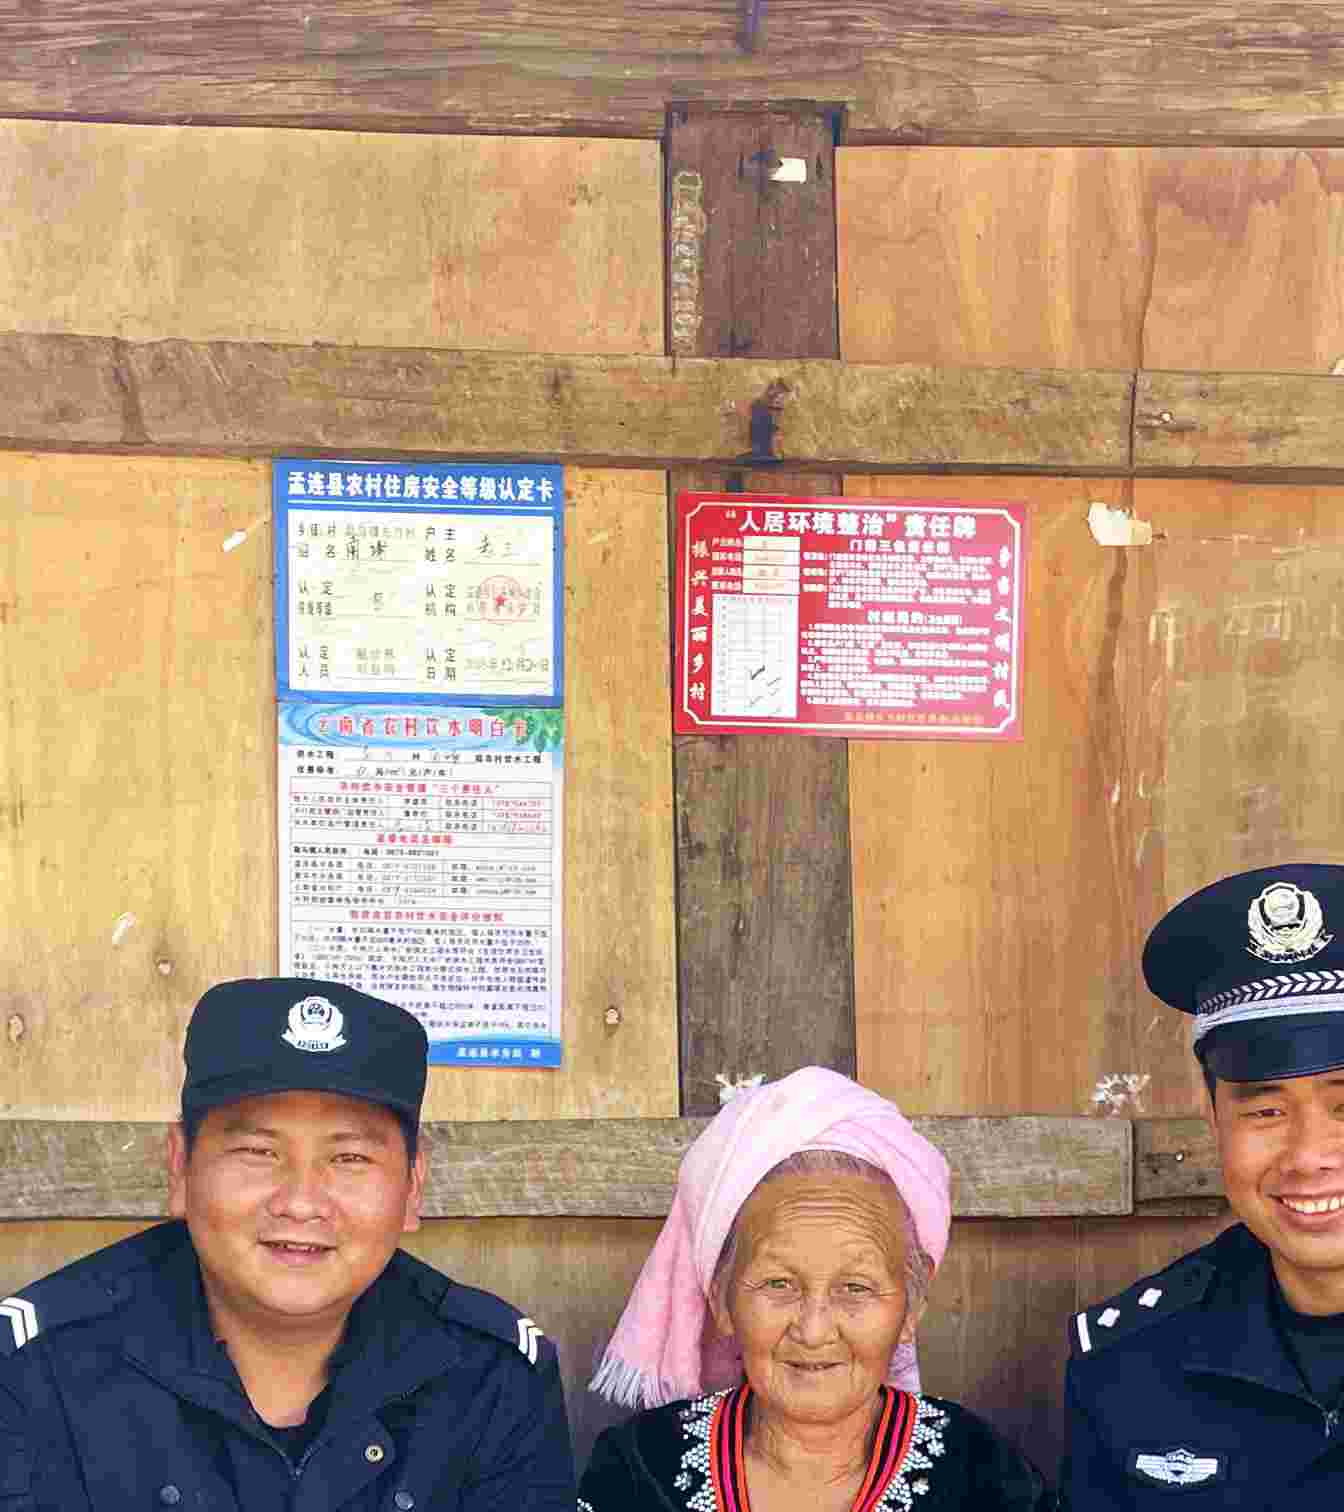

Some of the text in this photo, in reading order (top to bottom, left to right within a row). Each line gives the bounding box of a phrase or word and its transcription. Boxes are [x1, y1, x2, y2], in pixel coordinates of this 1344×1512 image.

[288, 471, 554, 502] 孟连县农村住房安全等级认定卡
